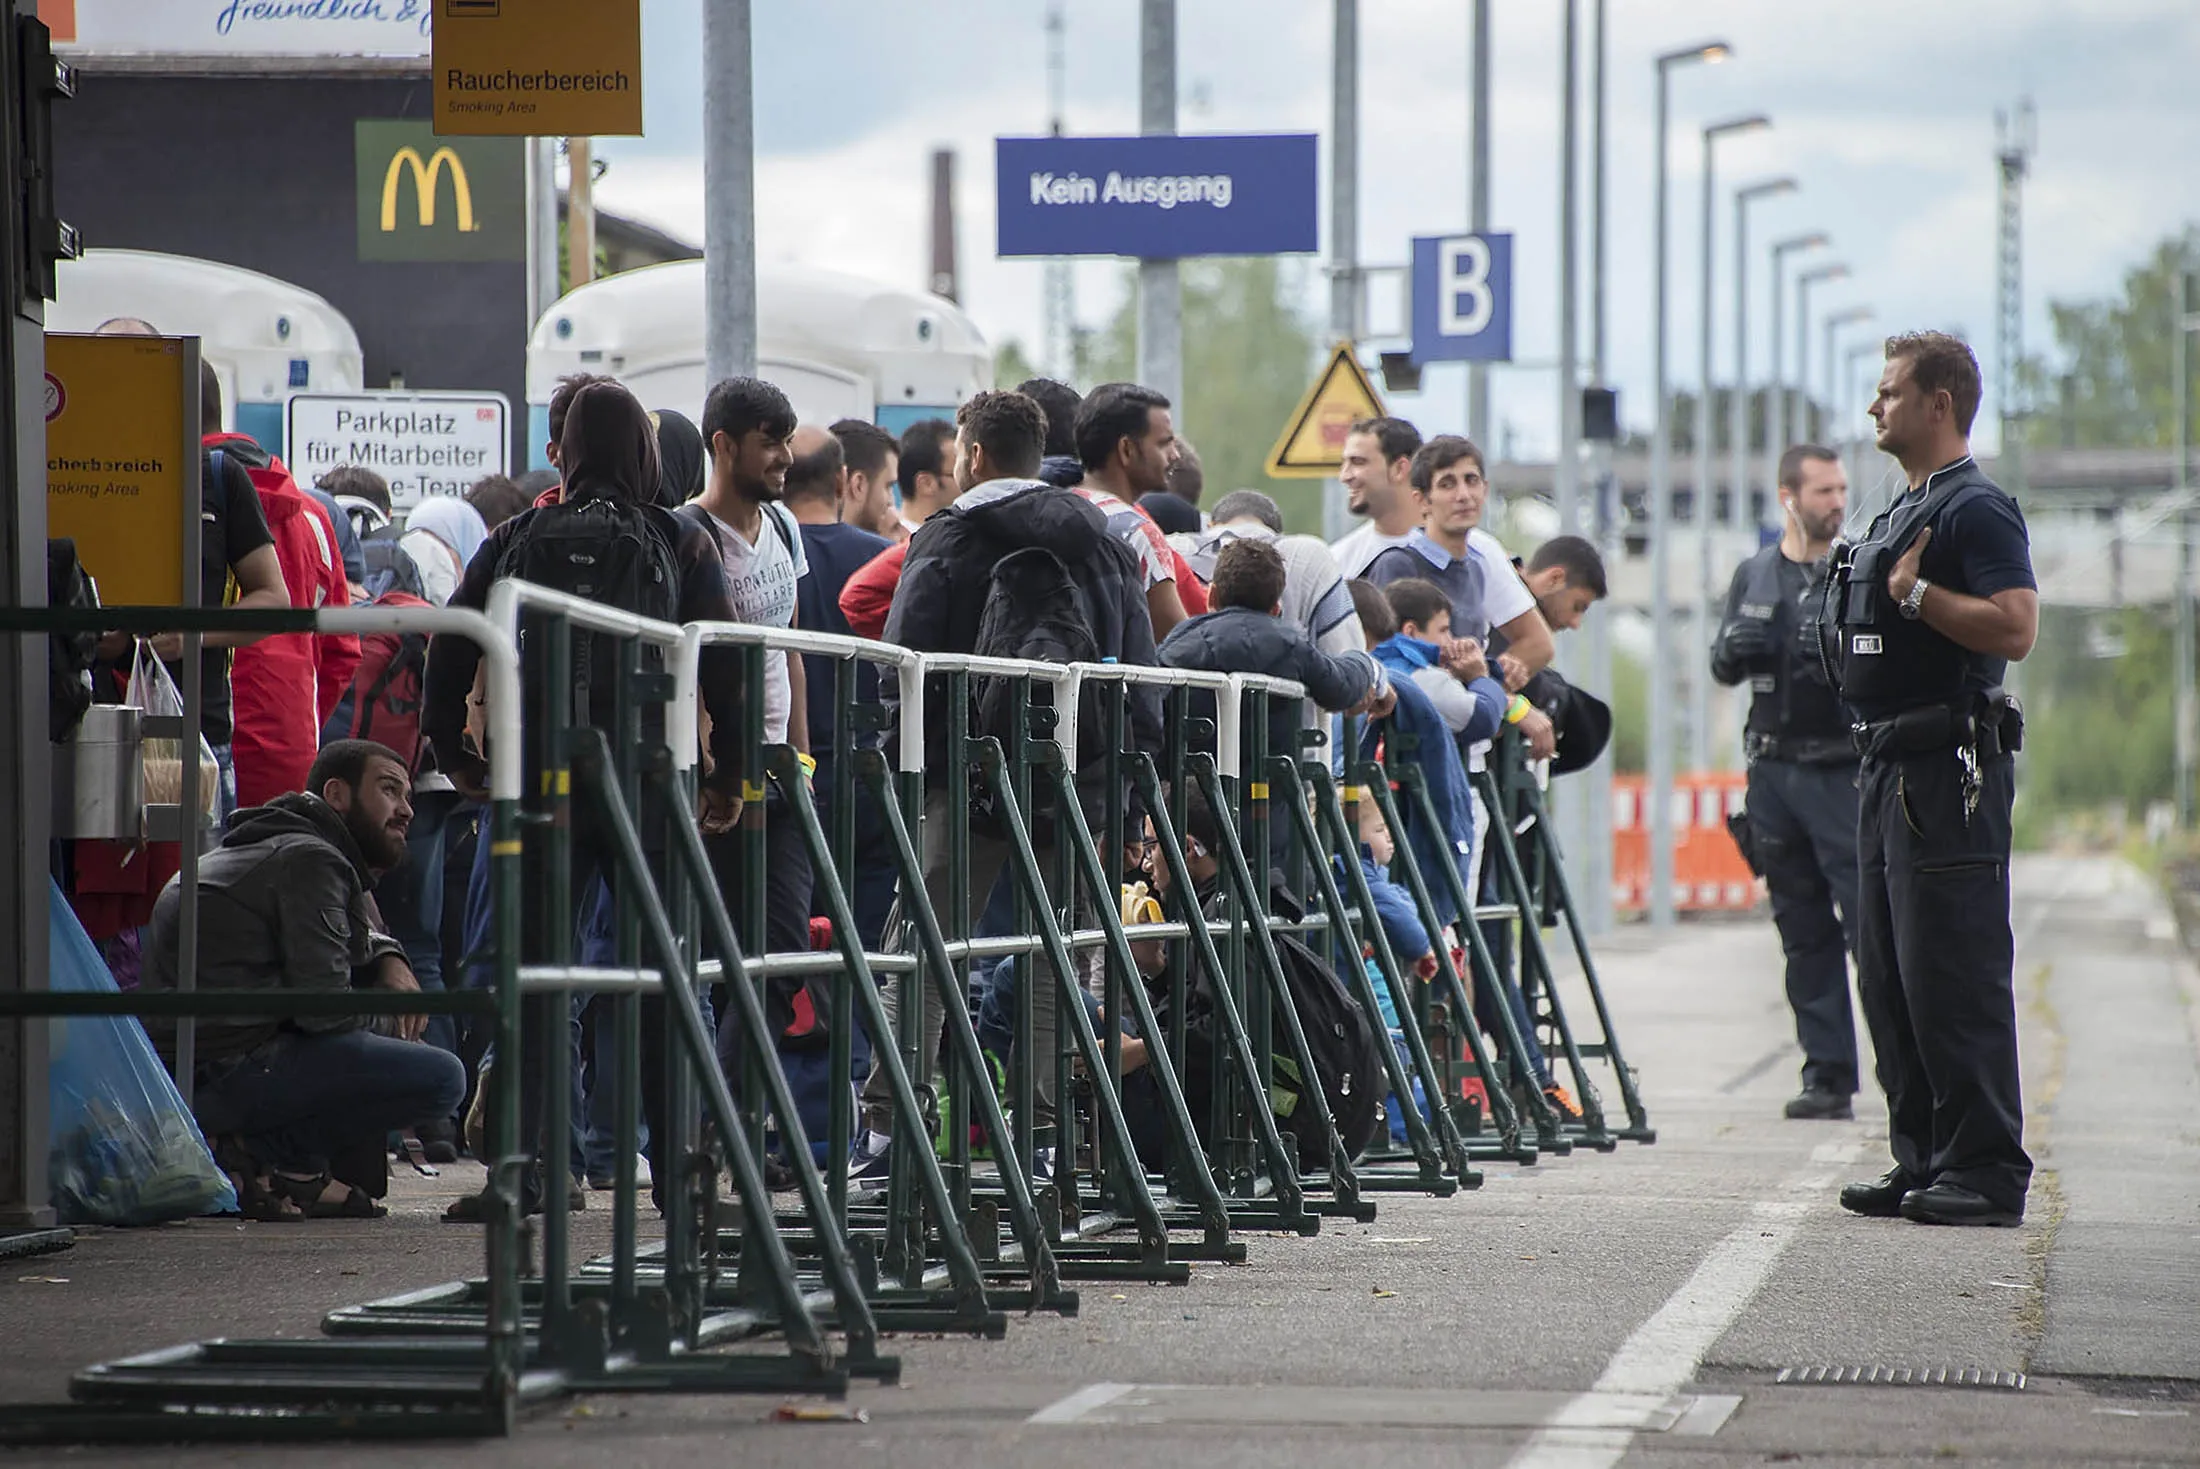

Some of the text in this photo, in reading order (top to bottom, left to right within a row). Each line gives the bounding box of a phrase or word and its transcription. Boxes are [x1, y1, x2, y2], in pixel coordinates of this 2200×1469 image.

[447, 69, 629, 91] Raucherbereich
[448, 101, 536, 116] Smoking Area
[1030, 171, 1232, 209] Kein Ausgang
[1438, 235, 1494, 336] B
[336, 410, 456, 438] Parkplatz
[47, 457, 162, 473] cherbereich
[306, 441, 487, 467] für Mitarbeiter
[103, 482, 140, 496] Area
